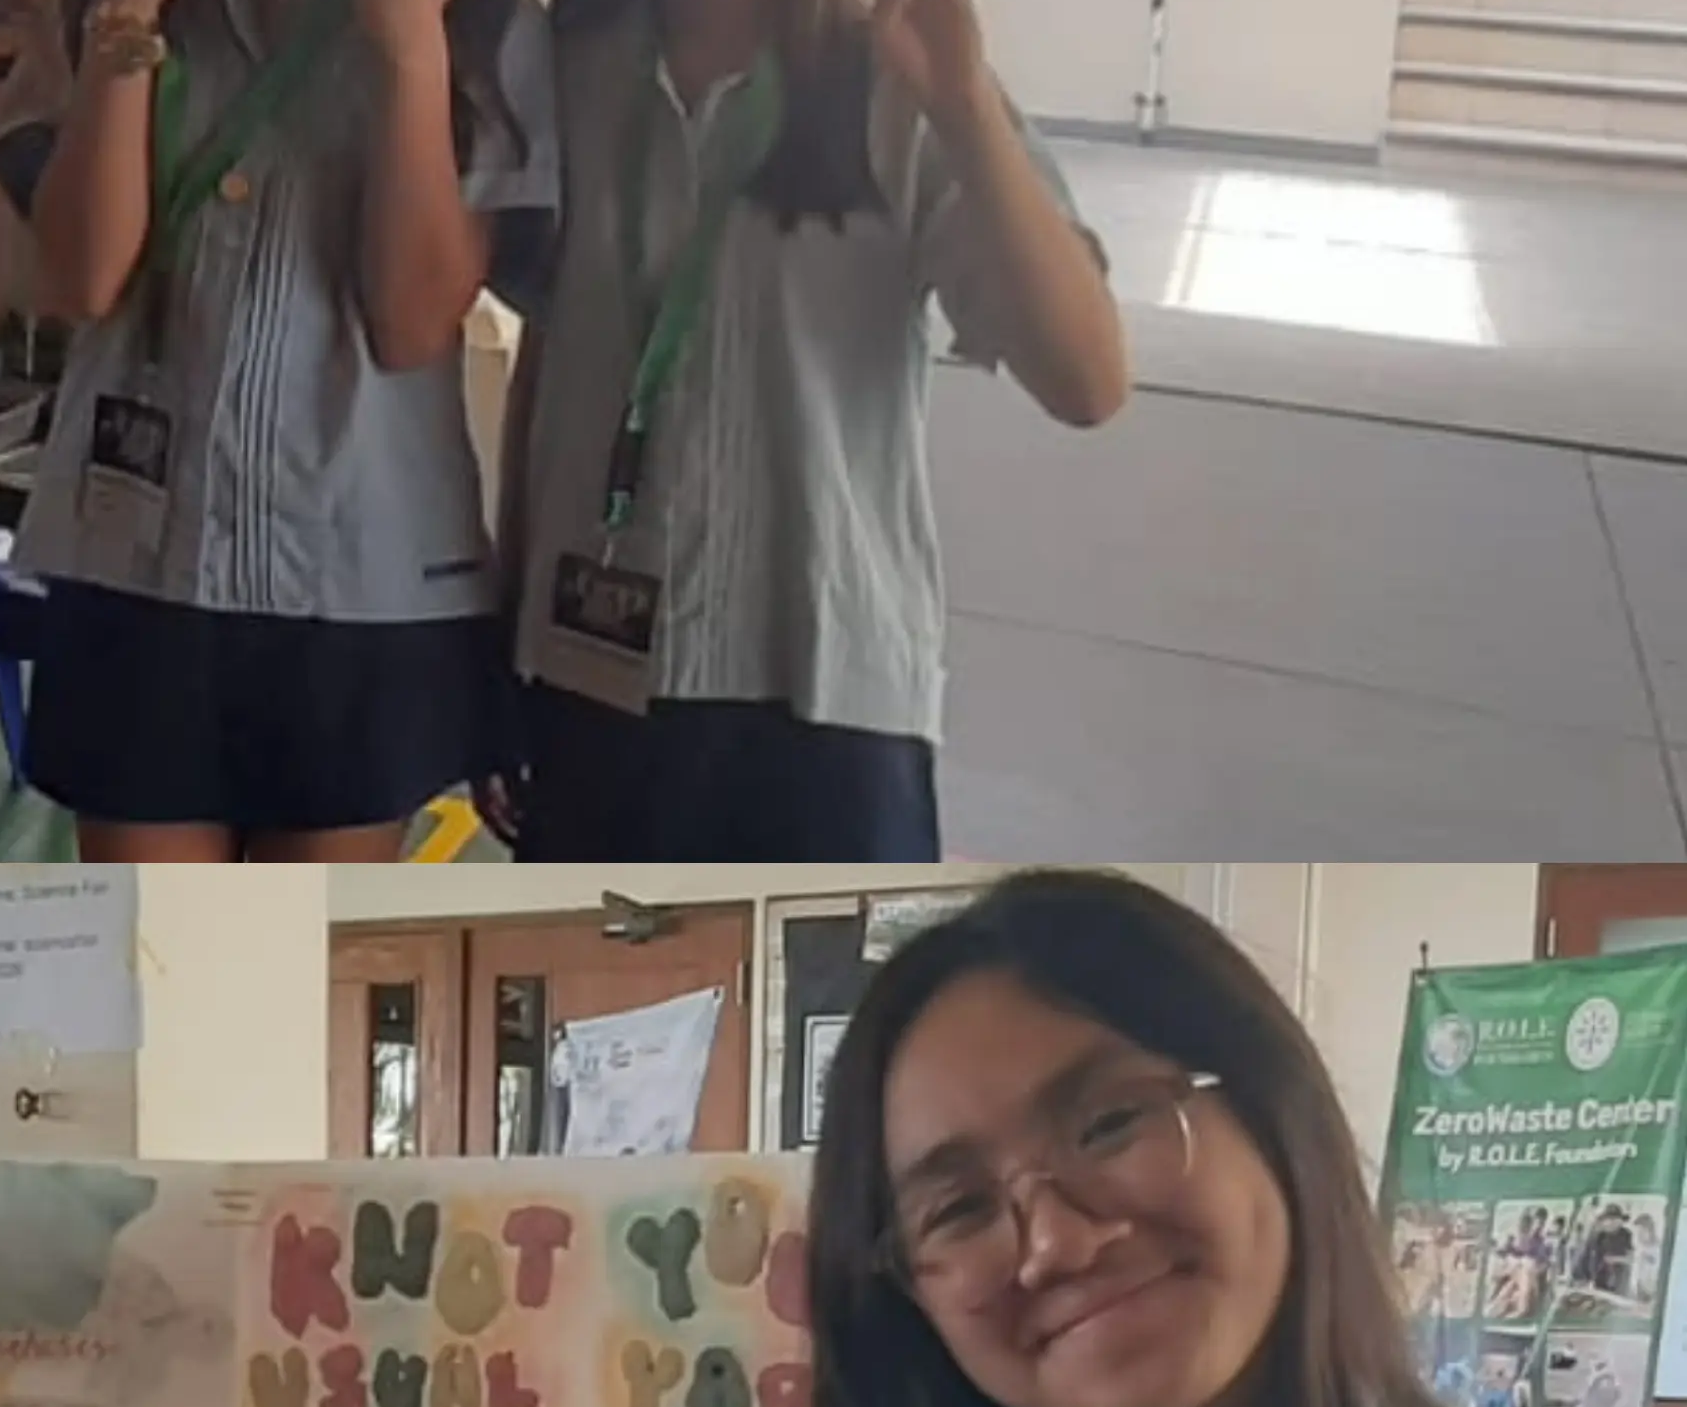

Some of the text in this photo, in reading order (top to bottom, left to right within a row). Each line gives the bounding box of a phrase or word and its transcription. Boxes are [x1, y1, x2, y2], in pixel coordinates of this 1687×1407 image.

[1412, 1097, 1676, 1135] ZeroWaste Center
[1438, 1146, 1464, 1174] by
[269, 1198, 572, 1340] KNOT
